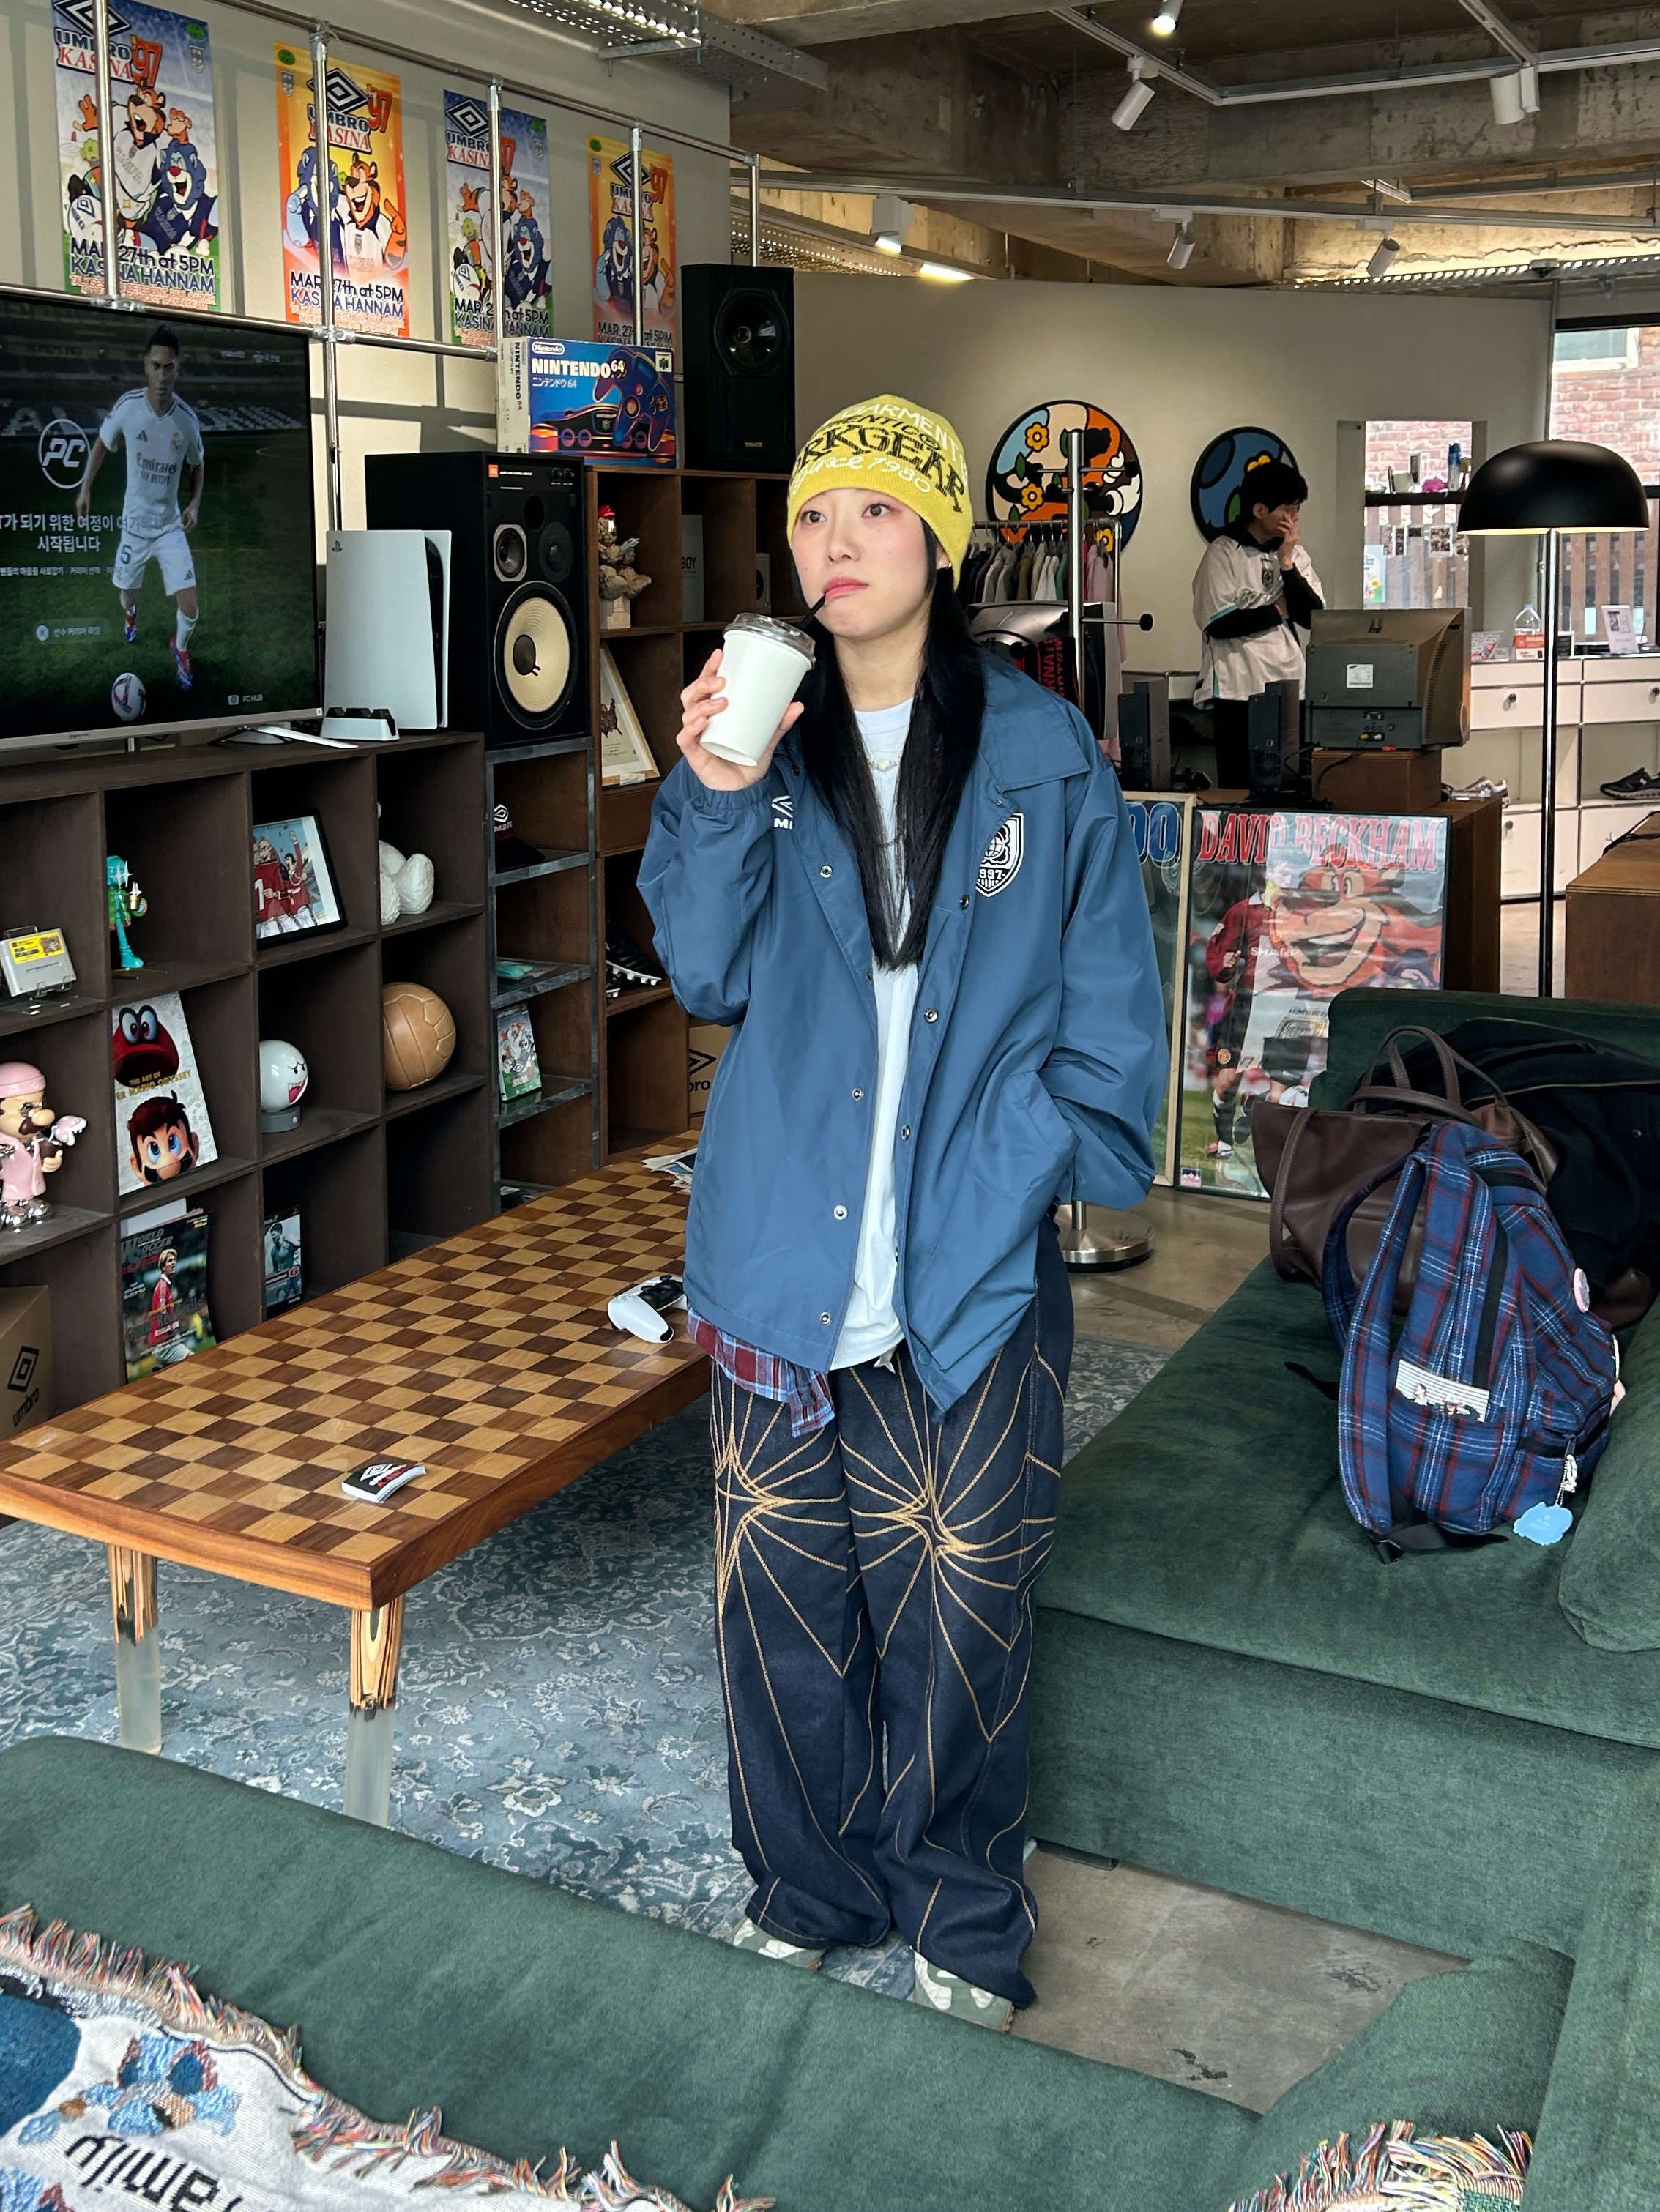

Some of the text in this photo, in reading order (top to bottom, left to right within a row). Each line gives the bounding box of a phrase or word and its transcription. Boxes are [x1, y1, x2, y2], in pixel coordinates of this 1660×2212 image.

[59, 46, 132, 80] KASNA
[448, 143, 489, 168] KASIN
[119, 245, 156, 267] 27th
[158, 253, 178, 269] at
[179, 255, 215, 276] 5PM
[71, 256, 215, 294] KASNA HANNAM
[359, 283, 373, 297] at
[376, 284, 403, 302] 5PM
[291, 287, 343, 310] KASA
[346, 297, 403, 319] HANNAM
[455, 313, 494, 330] KASIN
[512, 308, 524, 321] at
[525, 310, 548, 324] 5PM
[654, 329, 672, 343] 5PM
[535, 343, 562, 353] Nintendo
[532, 357, 611, 379] NINTENDO
[611, 360, 625, 374] 64
[567, 379, 577, 388] 64
[20, 514, 46, 532] 되기
[48, 515, 75, 532] 위한
[77, 515, 113, 532] 여정이
[37, 535, 101, 553] 시작됩니다
[120, 544, 132, 565] 5
[1198, 812, 1440, 873] DAVID BECKHAM
[129, 1070, 161, 1086] THE ART OF
[129, 1081, 156, 1097] MARIO
[157, 1069, 191, 1087] ODYSSEY
